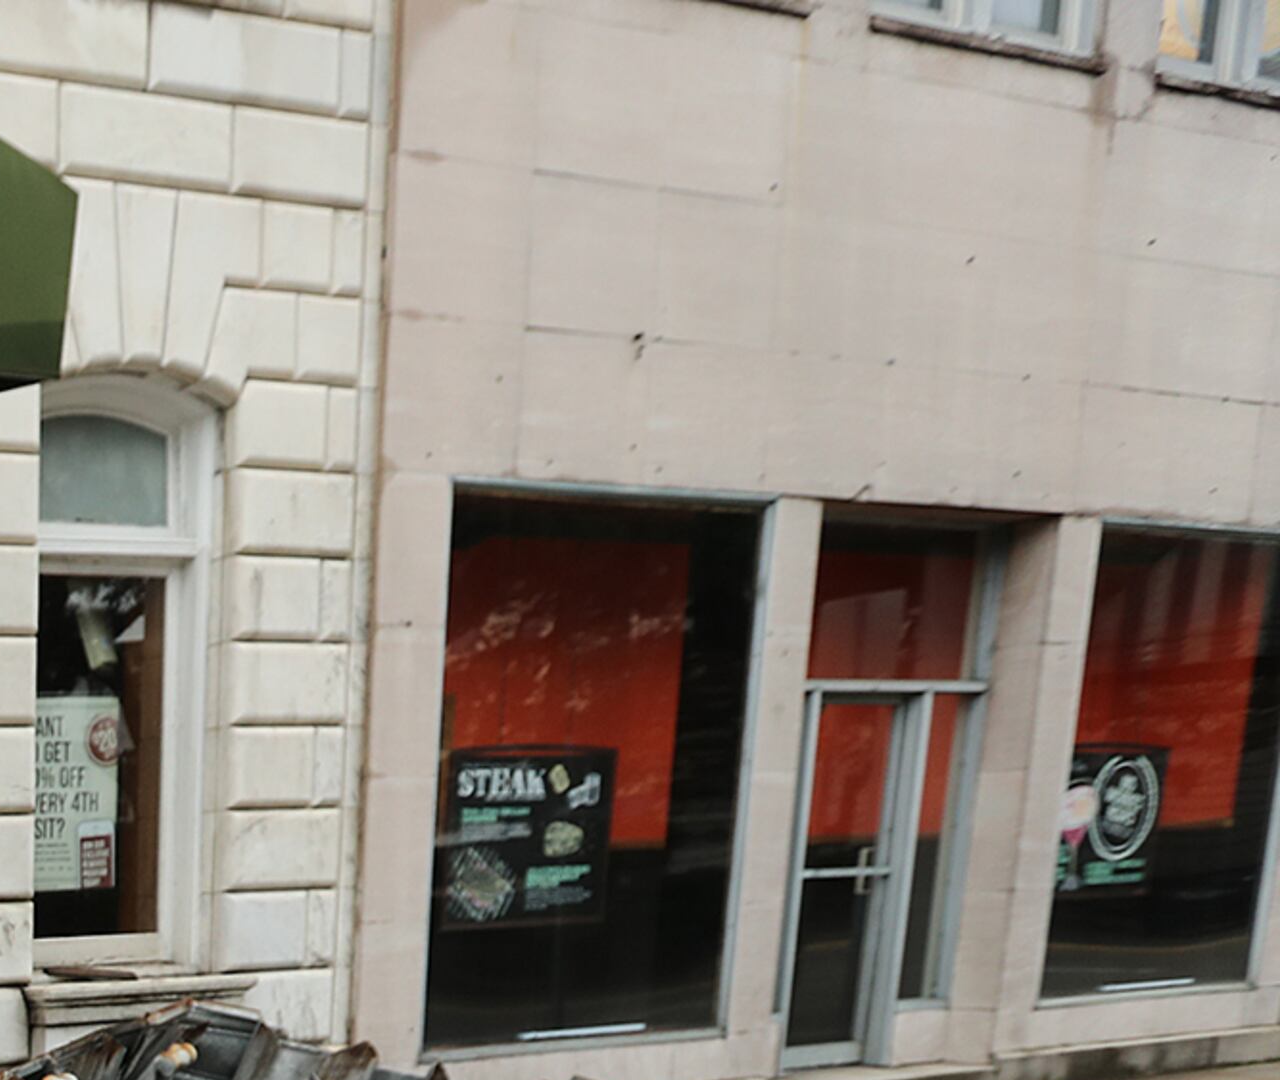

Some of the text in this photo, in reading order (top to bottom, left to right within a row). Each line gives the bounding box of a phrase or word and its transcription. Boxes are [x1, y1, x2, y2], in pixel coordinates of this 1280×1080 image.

[36, 716, 64, 737] ANT
[44, 741, 71, 763] GET
[60, 766, 86, 788] OFF
[71, 791, 100, 813] 4TH
[34, 817, 66, 839] SIT?
